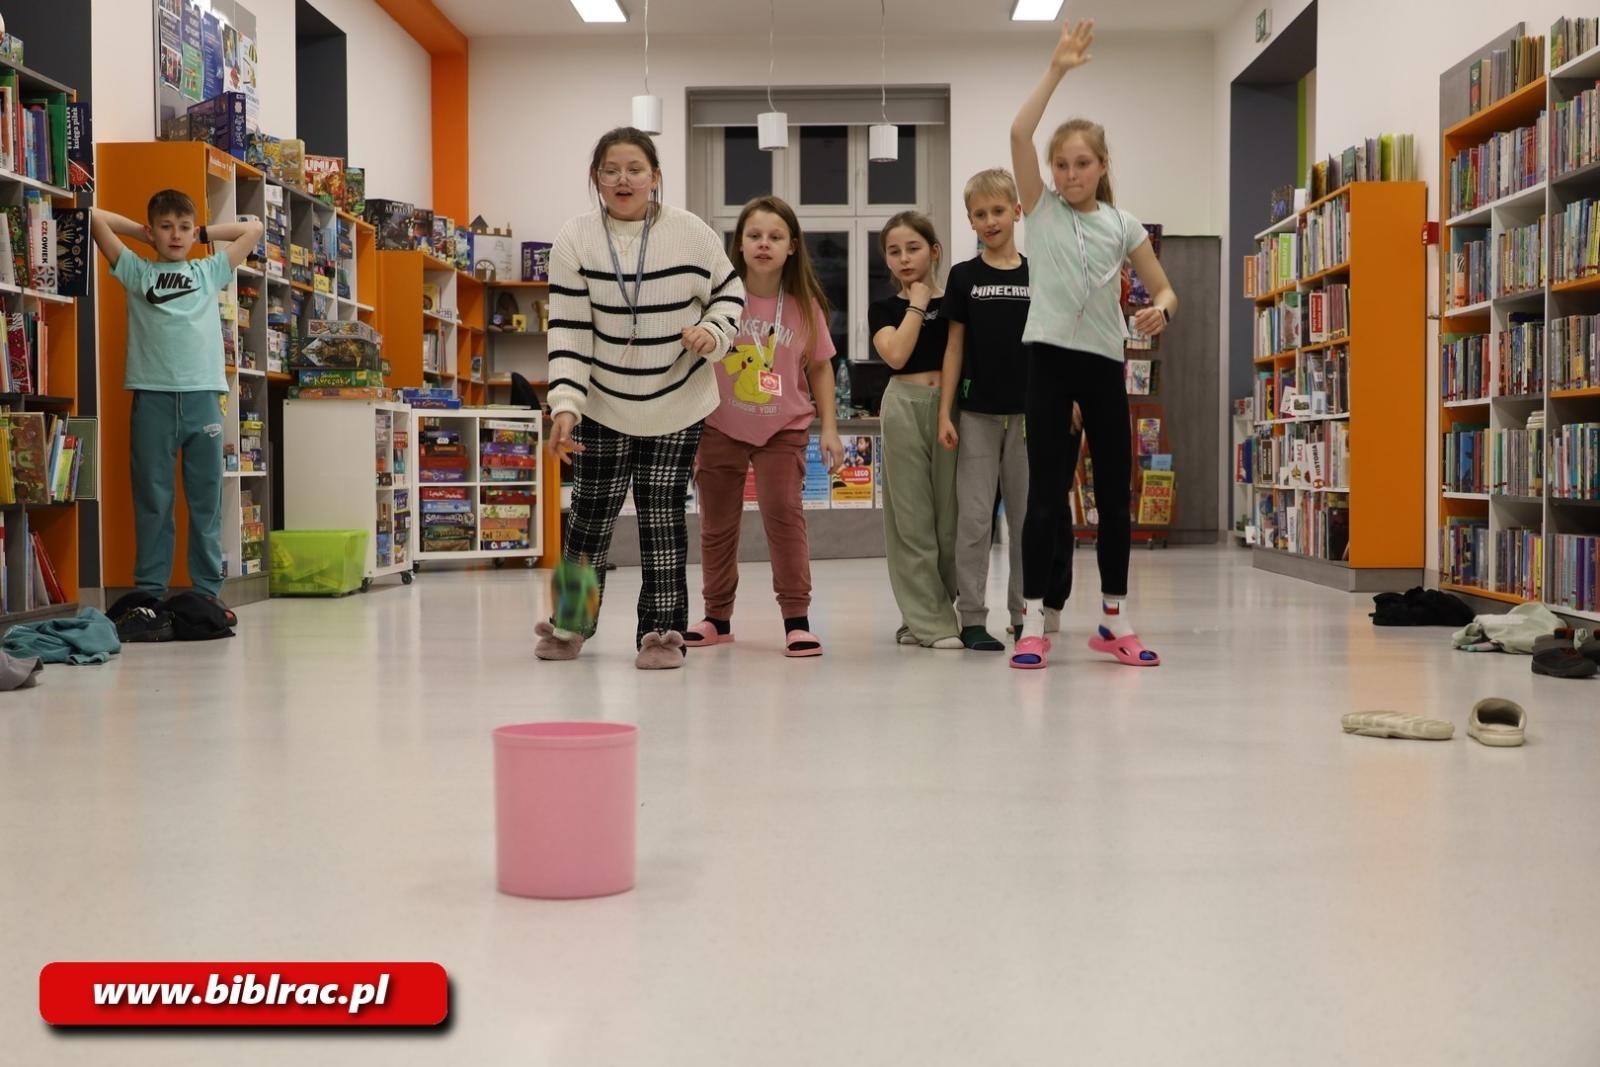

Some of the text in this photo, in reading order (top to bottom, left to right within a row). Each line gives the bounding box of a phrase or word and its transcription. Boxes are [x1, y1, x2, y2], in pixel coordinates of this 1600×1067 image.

[304, 159, 340, 172] UMIA
[155, 272, 193, 289] NIKE
[1312, 445, 1321, 476] HISTORIA
